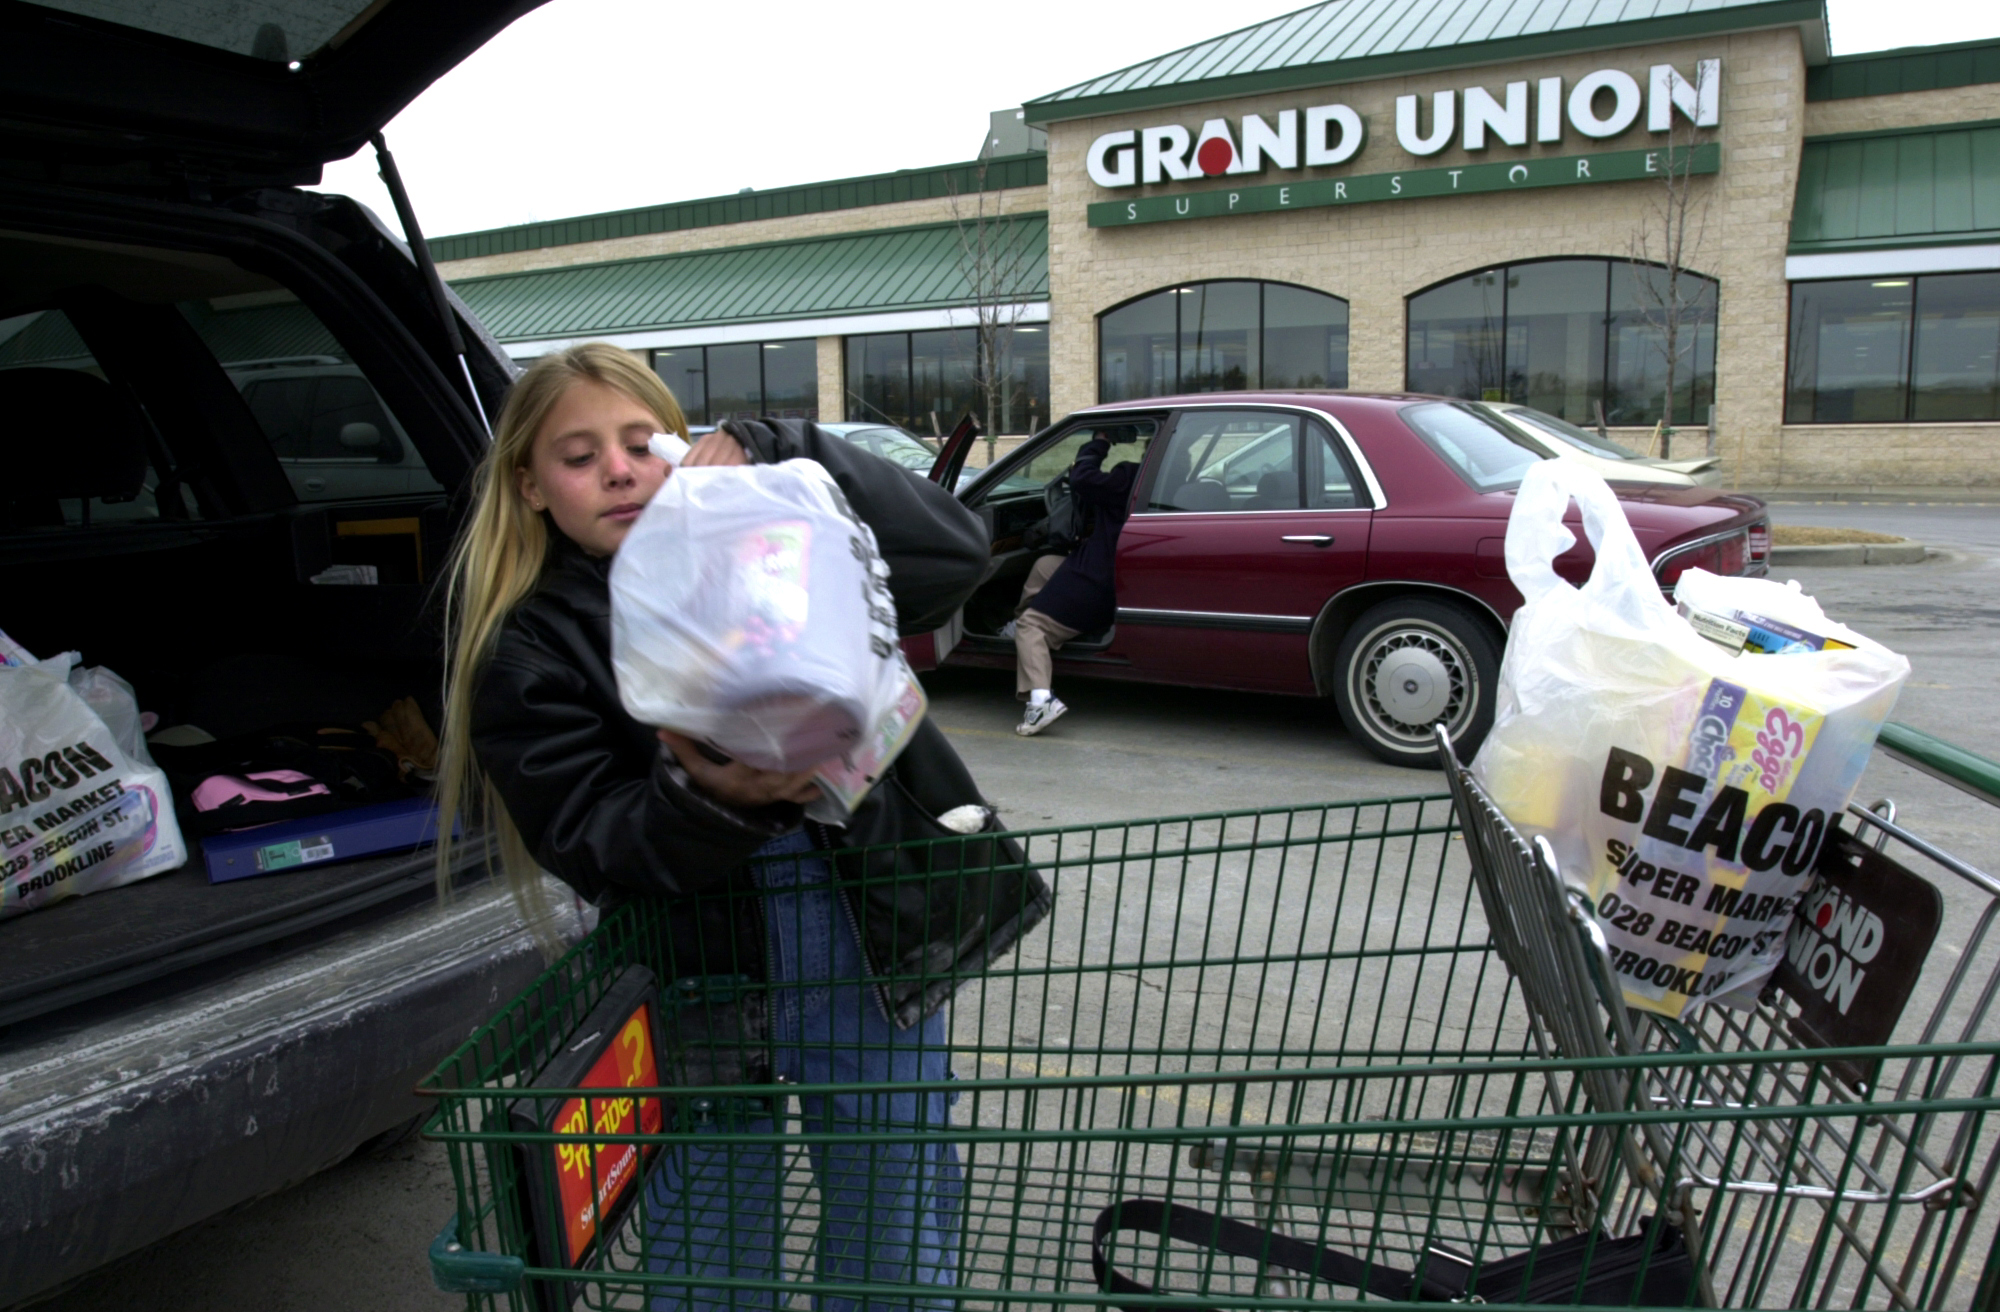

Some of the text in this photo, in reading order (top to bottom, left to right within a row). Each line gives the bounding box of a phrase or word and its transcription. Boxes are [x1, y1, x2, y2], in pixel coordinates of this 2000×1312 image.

[1086, 58, 1722, 188] GRAND UNION
[1126, 152, 1660, 220] SUPERSTORE
[1751, 707, 1804, 795] Eggo
[0, 779, 126, 850] ER MARKET
[33, 818, 100, 862] BEACON
[102, 806, 129, 828] ST.
[1600, 746, 1842, 877] BEACO
[17, 840, 115, 899] BROOKLINE
